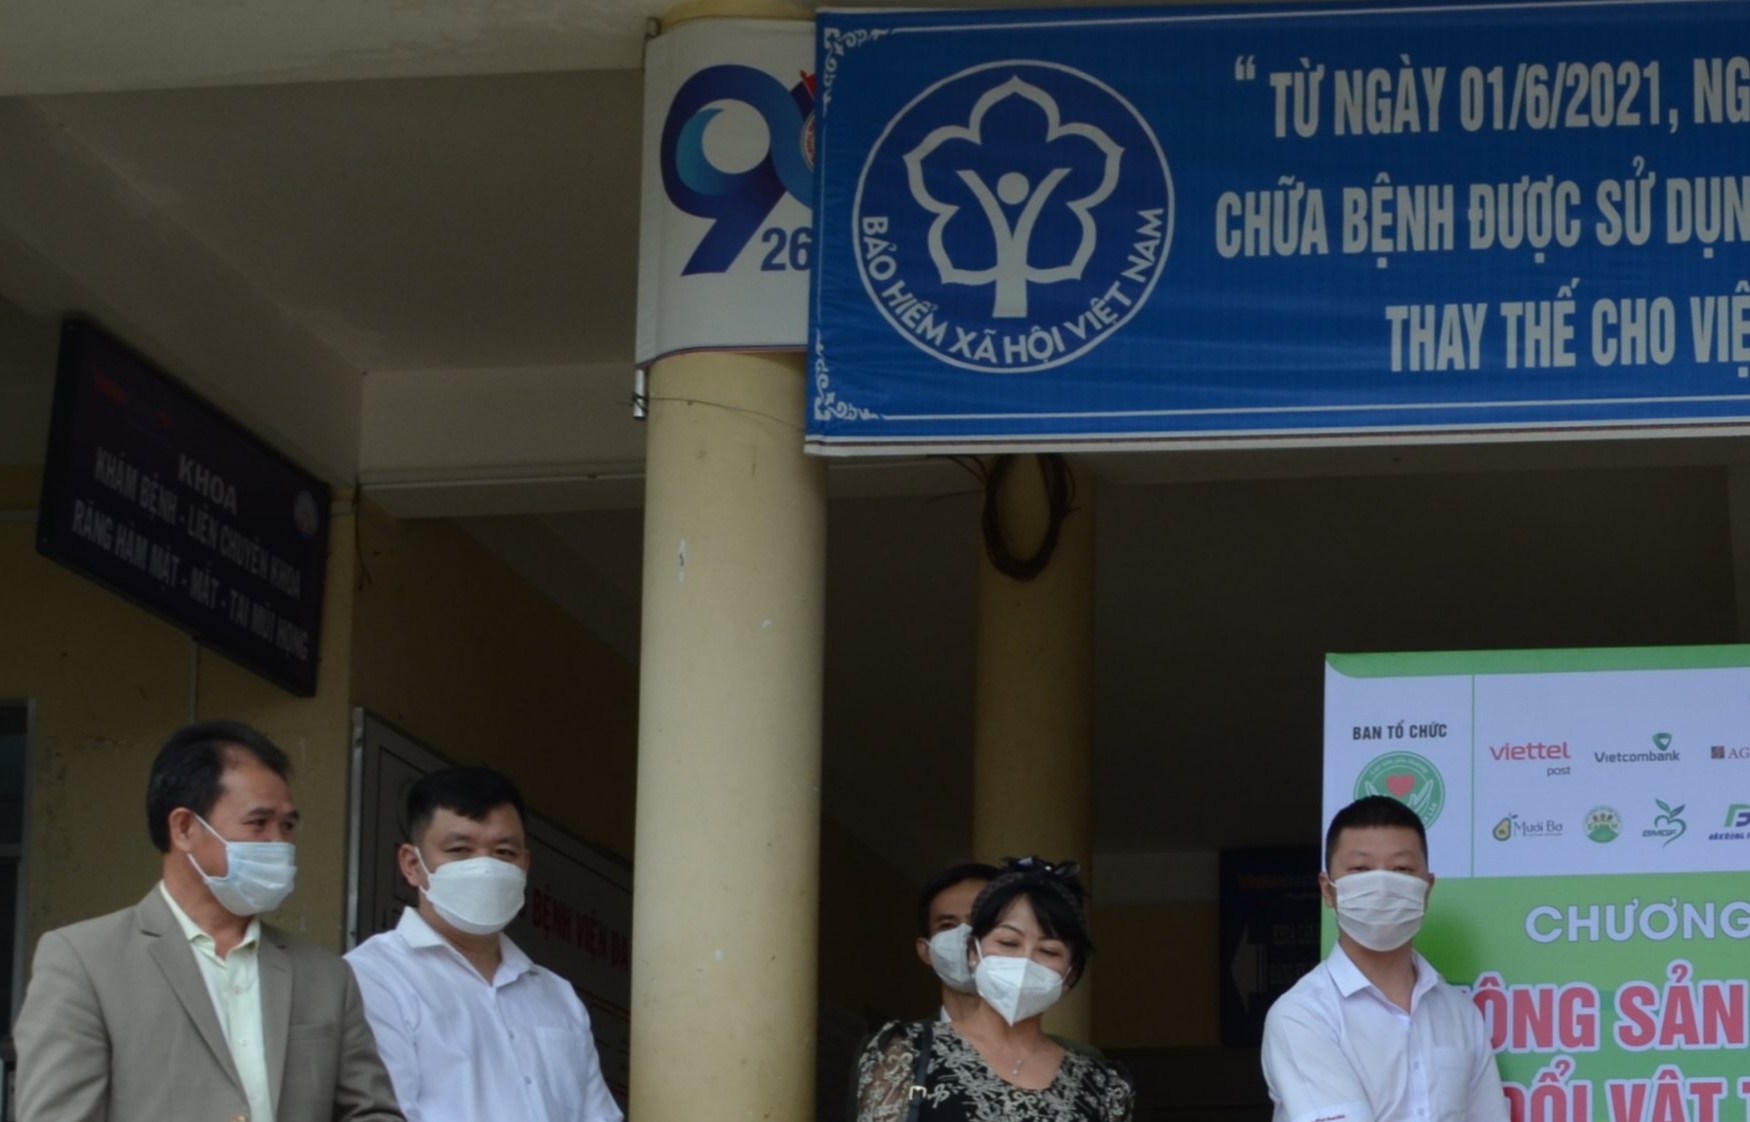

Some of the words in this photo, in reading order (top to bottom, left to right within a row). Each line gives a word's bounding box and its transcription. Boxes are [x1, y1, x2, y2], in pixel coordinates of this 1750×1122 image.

[1335, 54, 1446, 135] NGÀY
[1461, 60, 1678, 133] 01/6/2021,
[1214, 174, 1329, 258] CHỮA
[1343, 172, 1454, 269] BỆNH
[1468, 176, 1582, 264] ĐƯỢC
[1596, 155, 1657, 246] SỬ
[861, 213, 895, 282] BẢO
[880, 277, 946, 349] HIỂM
[951, 328, 999, 365] XÃ
[1003, 327, 1066, 366] HỘI
[1066, 280, 1134, 342] VIỆT
[1119, 207, 1166, 286] NAM
[1385, 302, 1487, 372] THAY
[1501, 278, 1579, 369] THẾ
[1590, 297, 1676, 366] CHO
[178, 453, 239, 516] KHOA
[1353, 725, 1381, 741] BAN
[1386, 719, 1404, 740] TỔ
[1408, 721, 1448, 739] CHỨC
[1489, 741, 1571, 762] viettel
[1594, 749, 1681, 764] Vietcombank
[1546, 766, 1572, 778] post
[1470, 973, 1598, 1050] ÔNG
[1614, 960, 1748, 1049] SẢN
